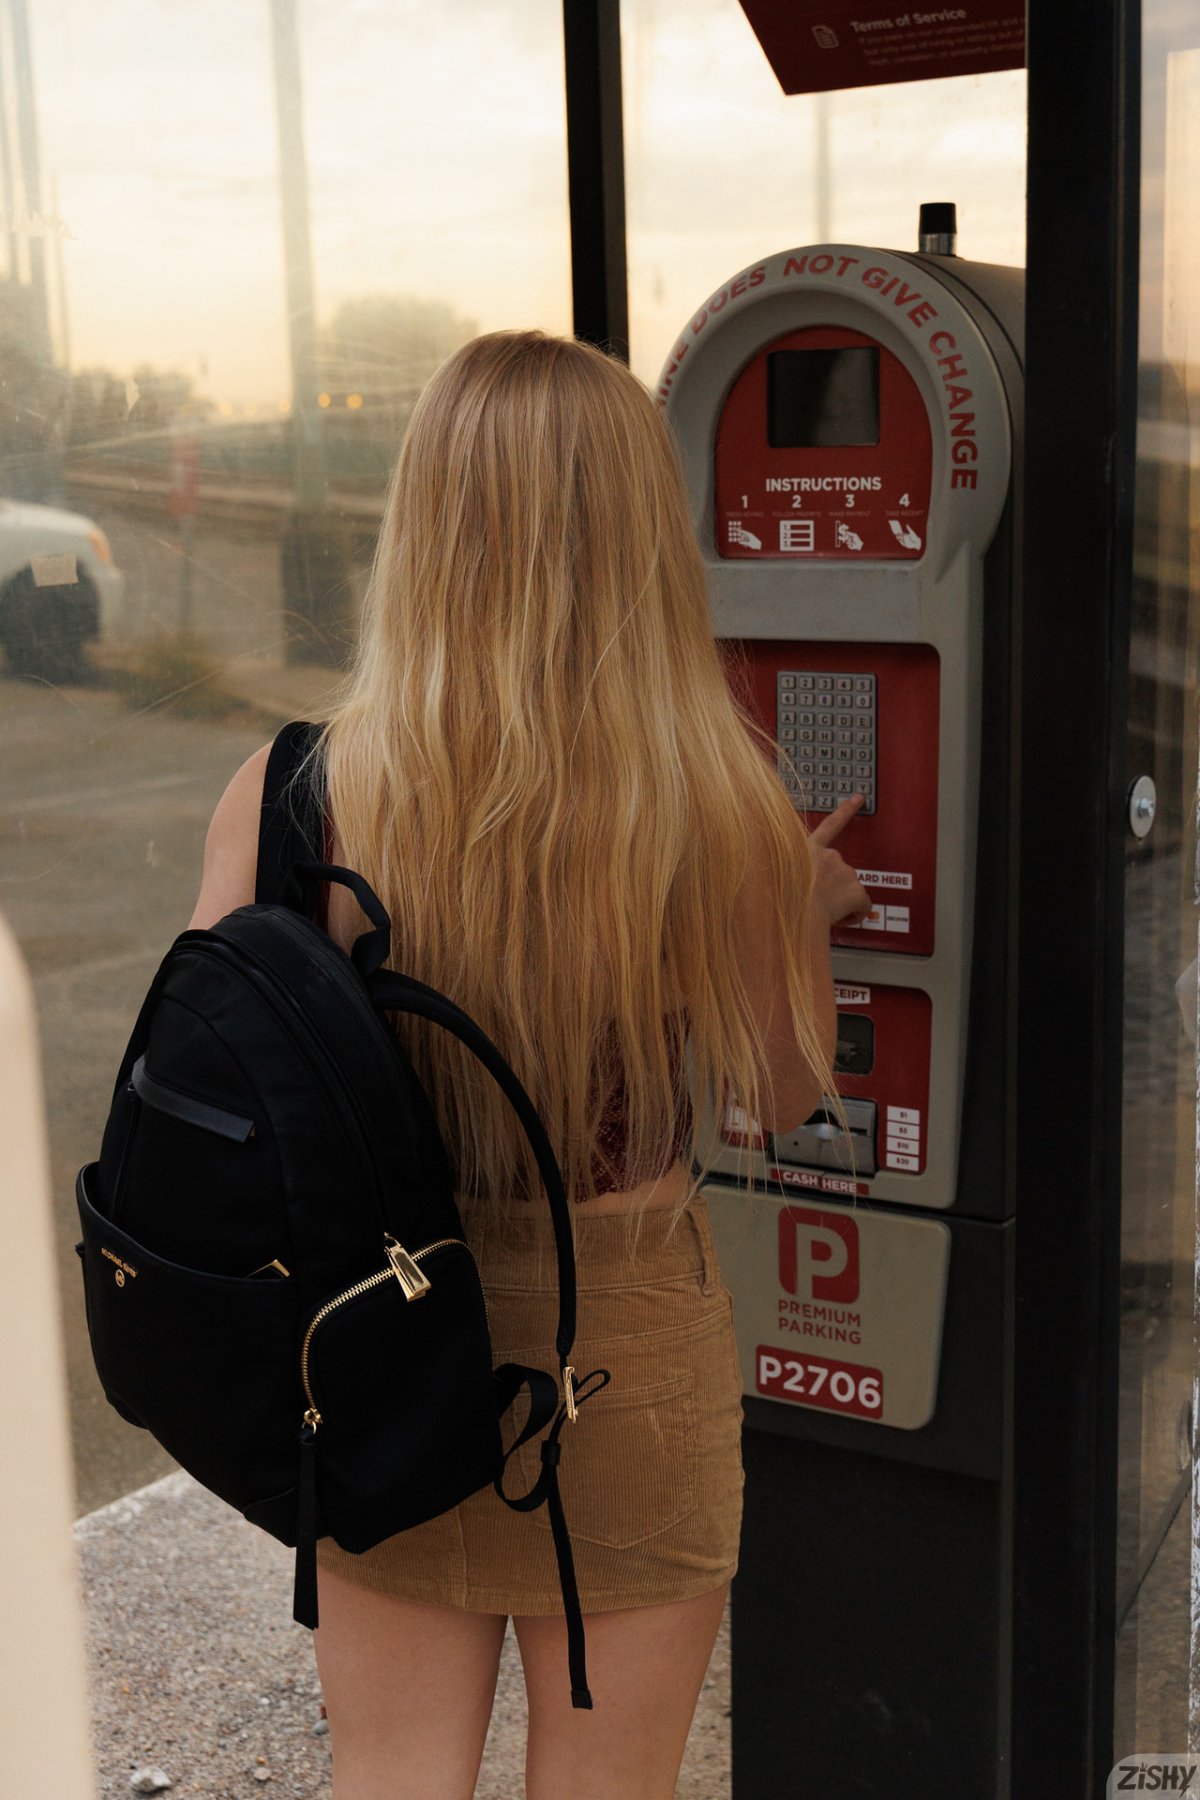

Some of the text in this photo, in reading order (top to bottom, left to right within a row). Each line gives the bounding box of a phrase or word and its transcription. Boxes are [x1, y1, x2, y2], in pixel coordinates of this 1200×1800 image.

[850, 18, 893, 33] Terms
[895, 14, 909, 27] of
[912, 8, 967, 25] Service
[691, 265, 766, 335] DOES
[783, 254, 859, 277] NOT
[862, 267, 938, 328] GIVE
[929, 331, 978, 489] CHANGE
[765, 477, 882, 492] INSTRUCTIONS
[741, 493, 910, 509] 1 2 3 4
[858, 874, 909, 885] ARD HERE
[832, 987, 867, 1001] CEIPT
[783, 1171, 856, 1192] CASH HERE
[778, 1300, 861, 1327] PREMIUM
[778, 1317, 861, 1345] PARKING
[759, 1355, 881, 1409] P2706
